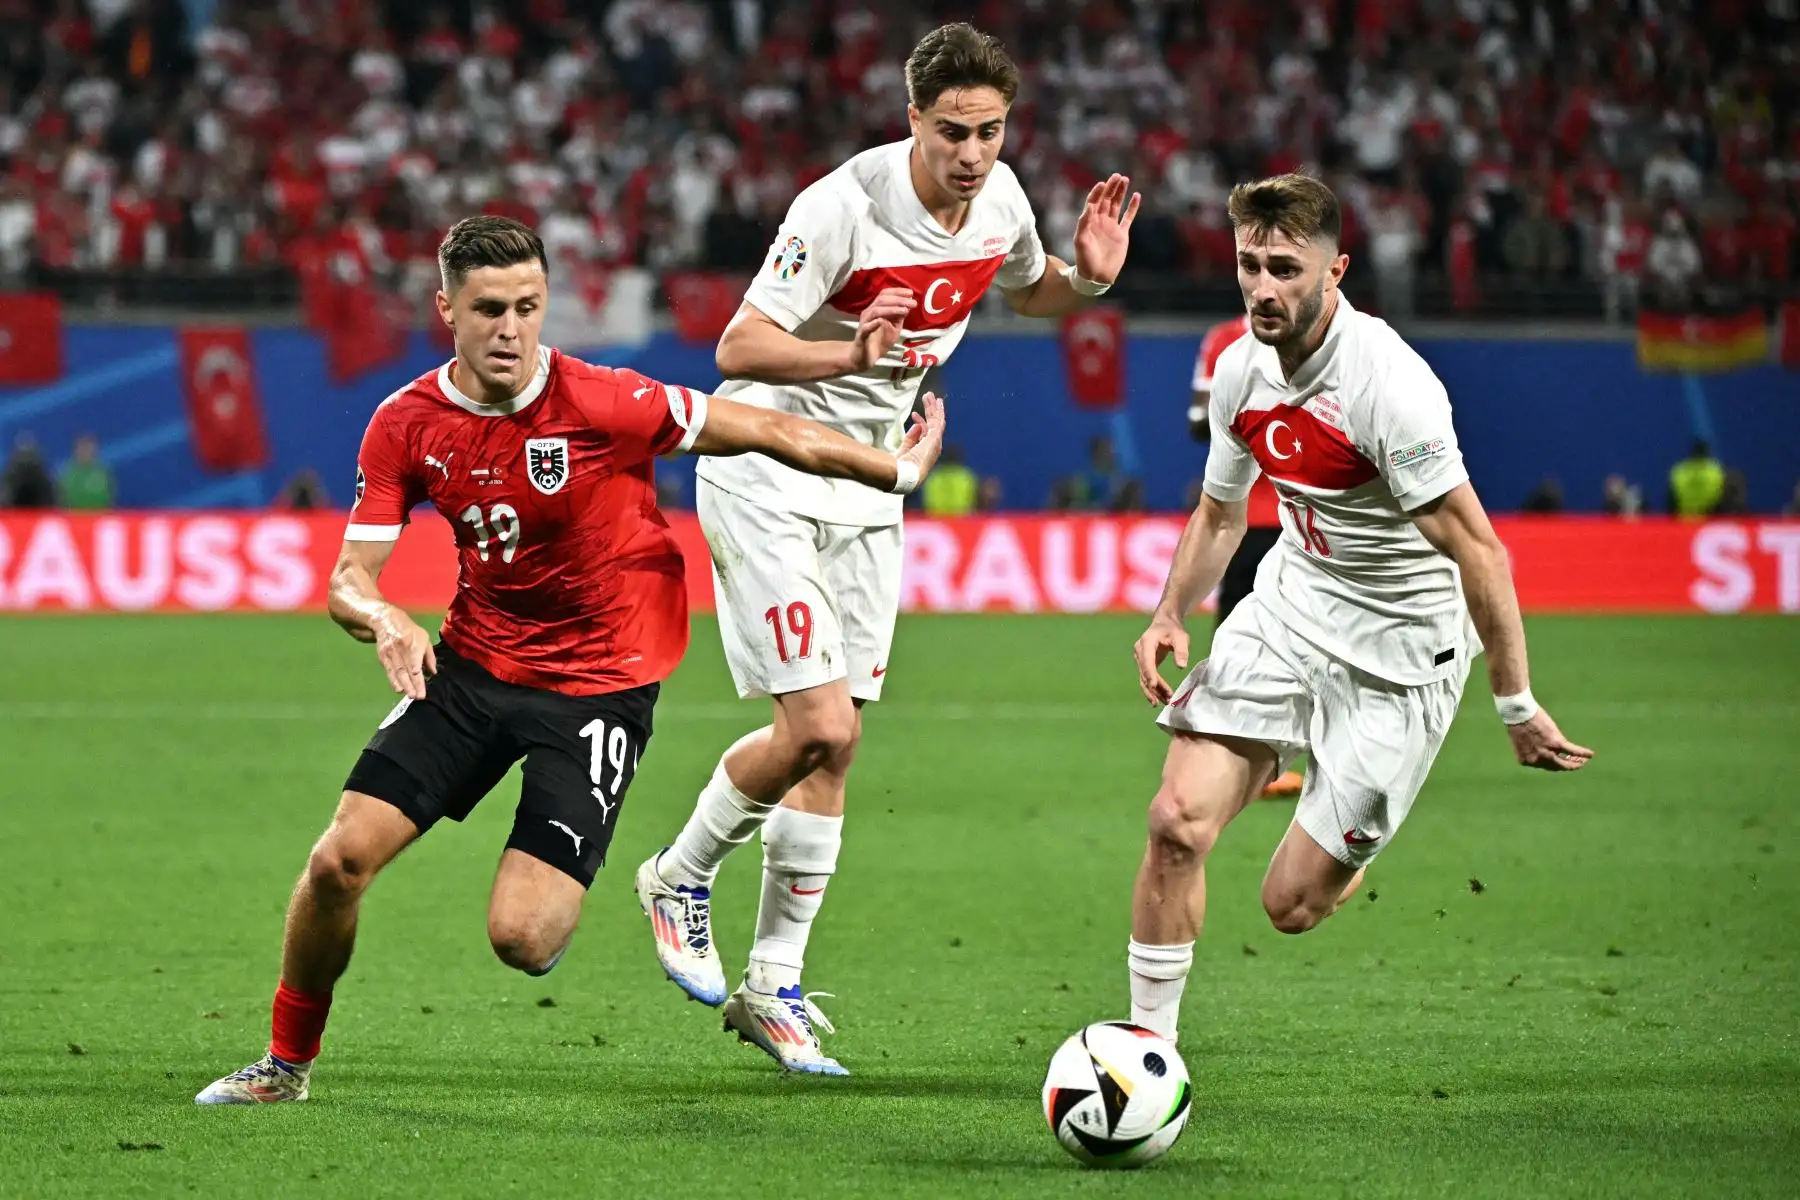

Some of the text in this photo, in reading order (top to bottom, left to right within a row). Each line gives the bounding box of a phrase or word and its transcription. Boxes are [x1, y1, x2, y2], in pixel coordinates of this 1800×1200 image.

[1390, 439, 1444, 464] FOUNDATION
[461, 503, 520, 564] 19
[1285, 501, 1333, 558] 16
[0, 515, 316, 612] AUSS
[1689, 520, 1800, 614] ST
[764, 600, 815, 665] 19
[578, 718, 627, 796] 19
